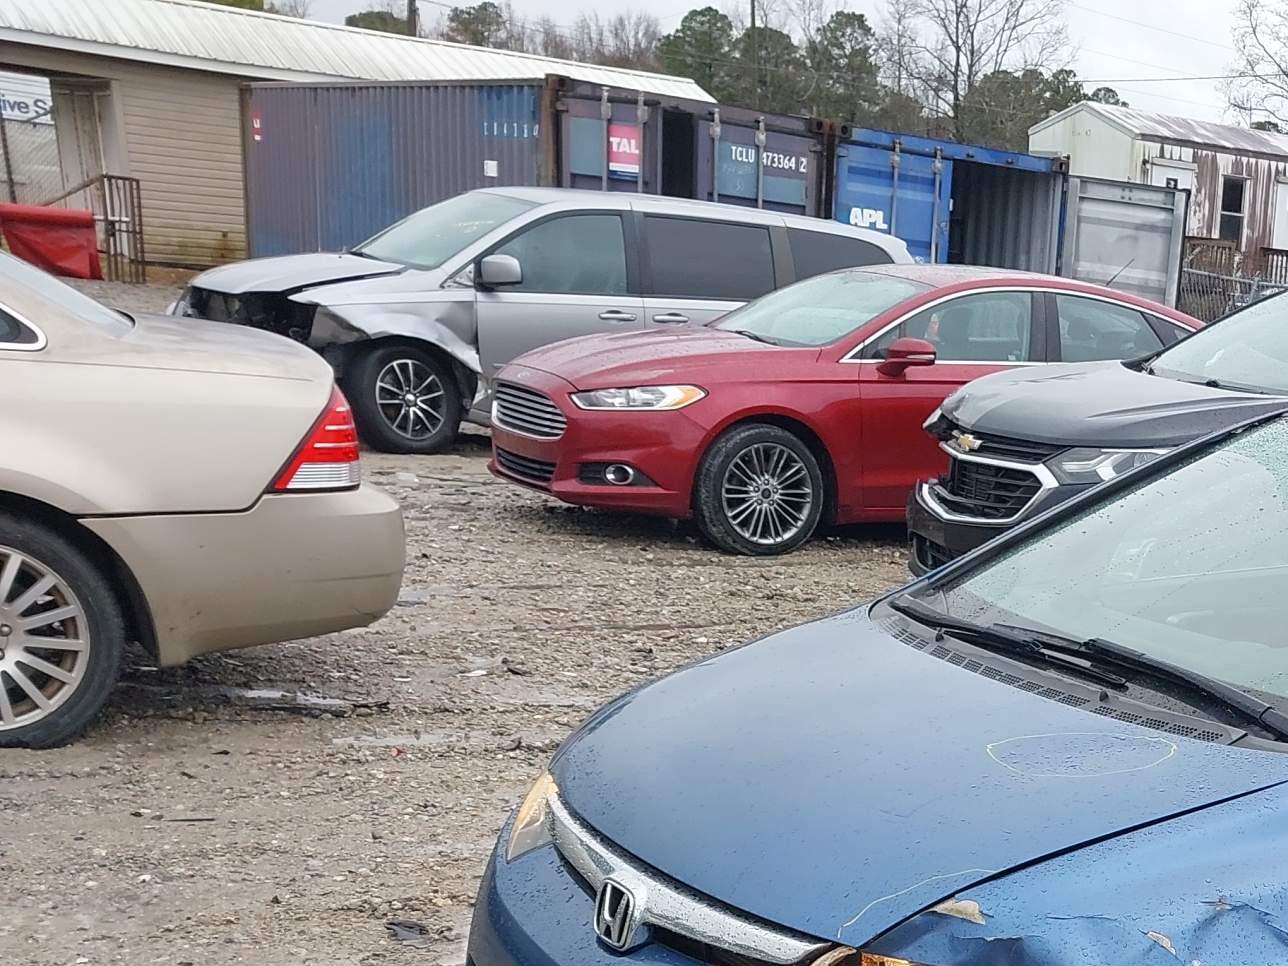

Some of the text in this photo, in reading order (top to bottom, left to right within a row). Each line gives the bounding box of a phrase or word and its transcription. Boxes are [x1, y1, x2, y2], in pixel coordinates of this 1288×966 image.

[0, 94, 29, 114] ive
[609, 136, 639, 154] TAL
[731, 146, 755, 163] TCLU
[800, 157, 808, 173] 2
[850, 207, 888, 230] APL
